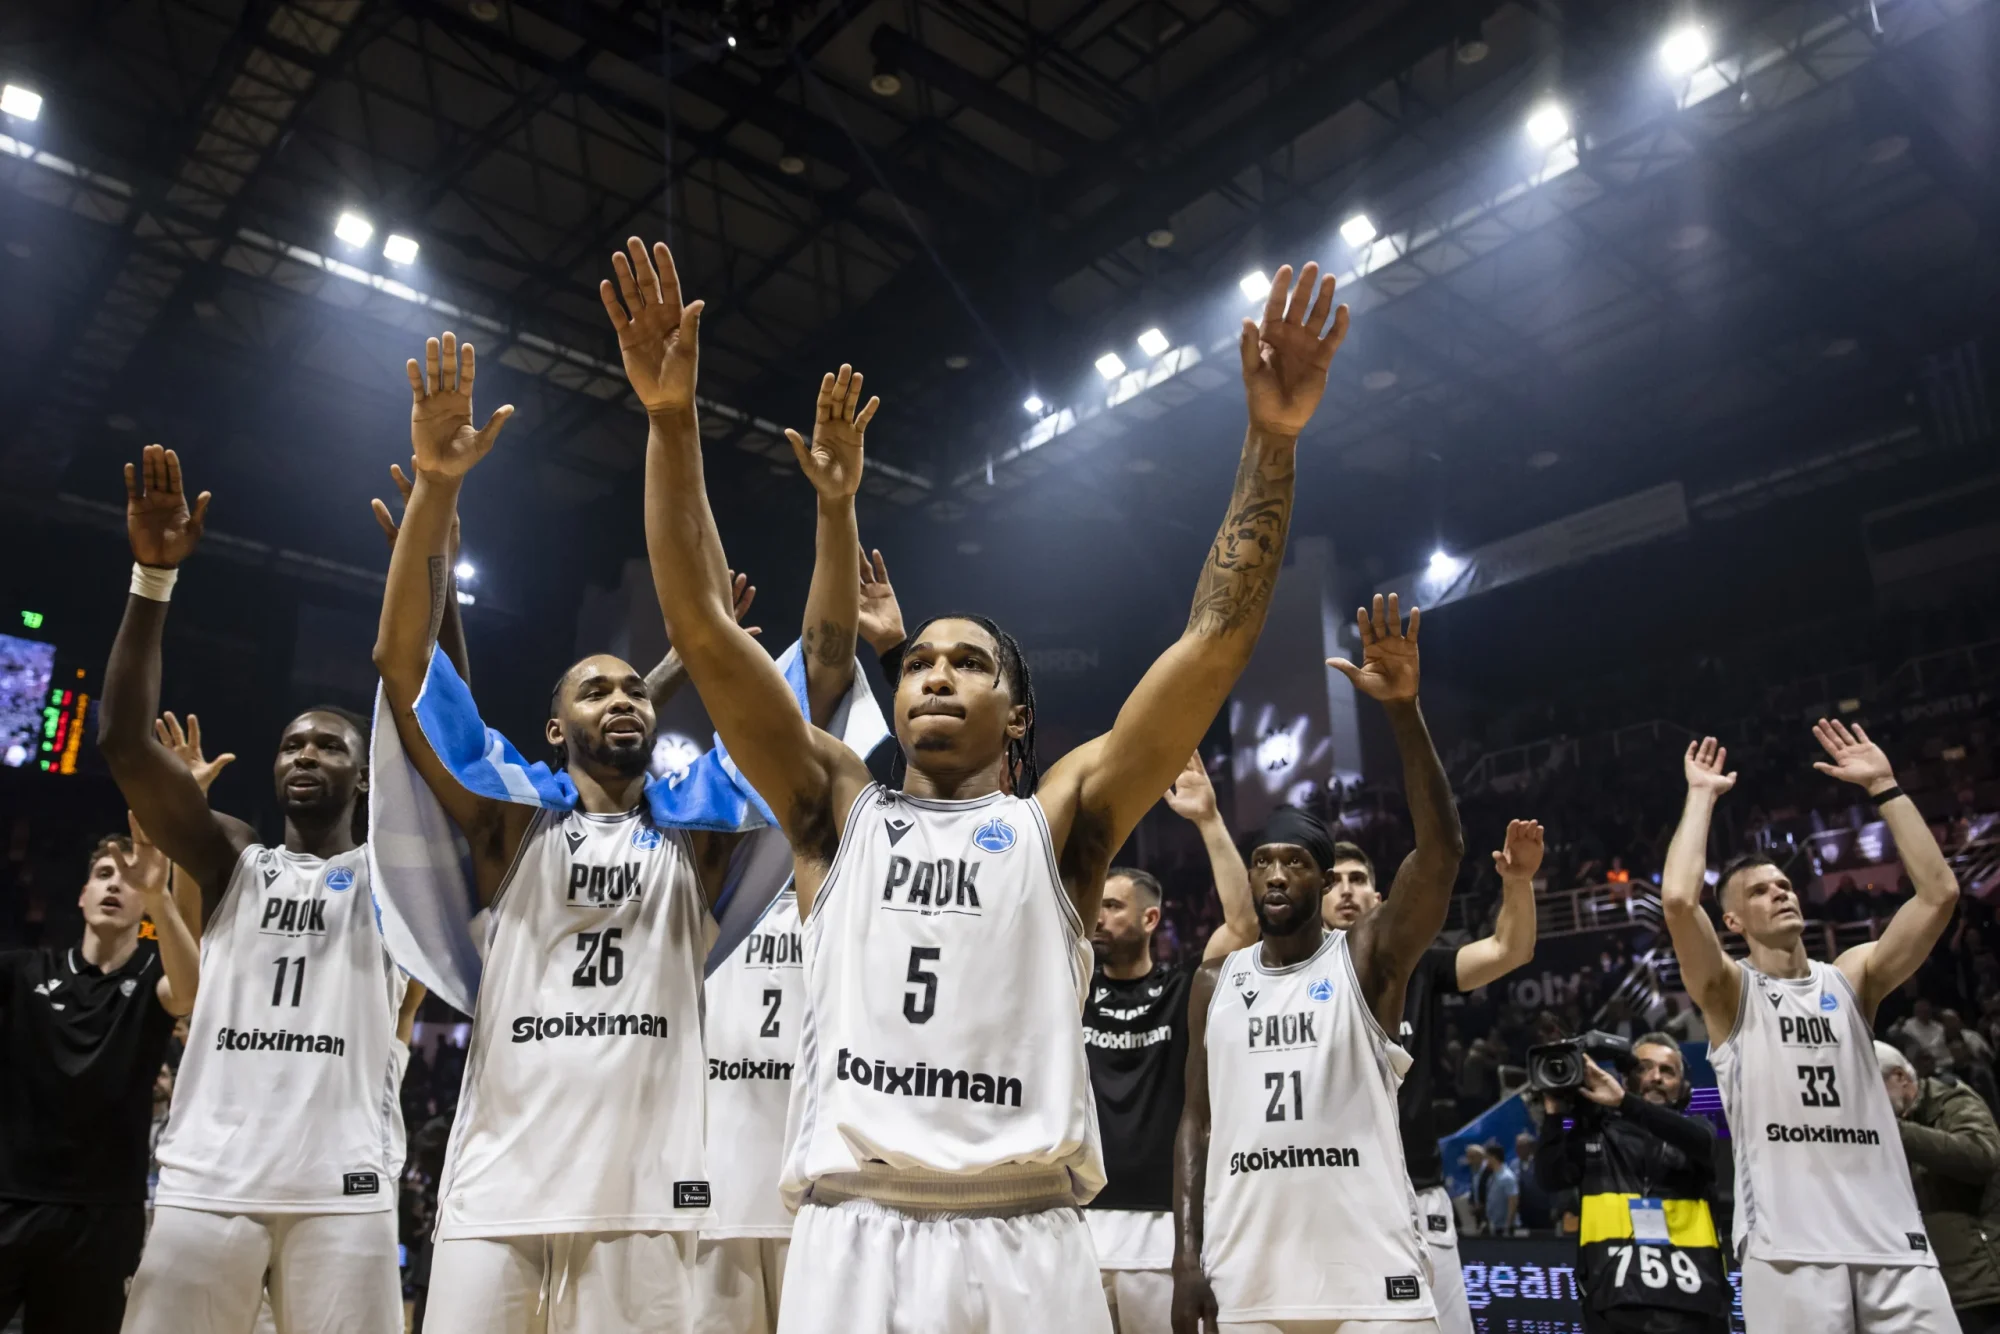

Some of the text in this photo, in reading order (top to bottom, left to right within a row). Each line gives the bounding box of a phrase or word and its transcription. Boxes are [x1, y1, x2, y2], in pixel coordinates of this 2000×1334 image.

[568, 862, 641, 902] PAOK
[882, 855, 982, 909] PAOK
[261, 898, 327, 931] PAOK
[572, 928, 624, 987] 26
[745, 932, 803, 965] PAOK
[271, 957, 306, 1007] 11
[903, 946, 941, 1024] 5
[511, 1012, 668, 1043] Stoiximan
[760, 989, 782, 1038] 2
[1248, 1011, 1317, 1048] PAOK
[1779, 1016, 1838, 1045] PAOK
[216, 1027, 345, 1057] Stoiximan
[1264, 1070, 1304, 1122] 21
[1797, 1065, 1841, 1107] 33
[1766, 1123, 1880, 1145] Stoiximan
[1230, 1145, 1360, 1176] Stoiximan
[1608, 1246, 1702, 1294] 759
